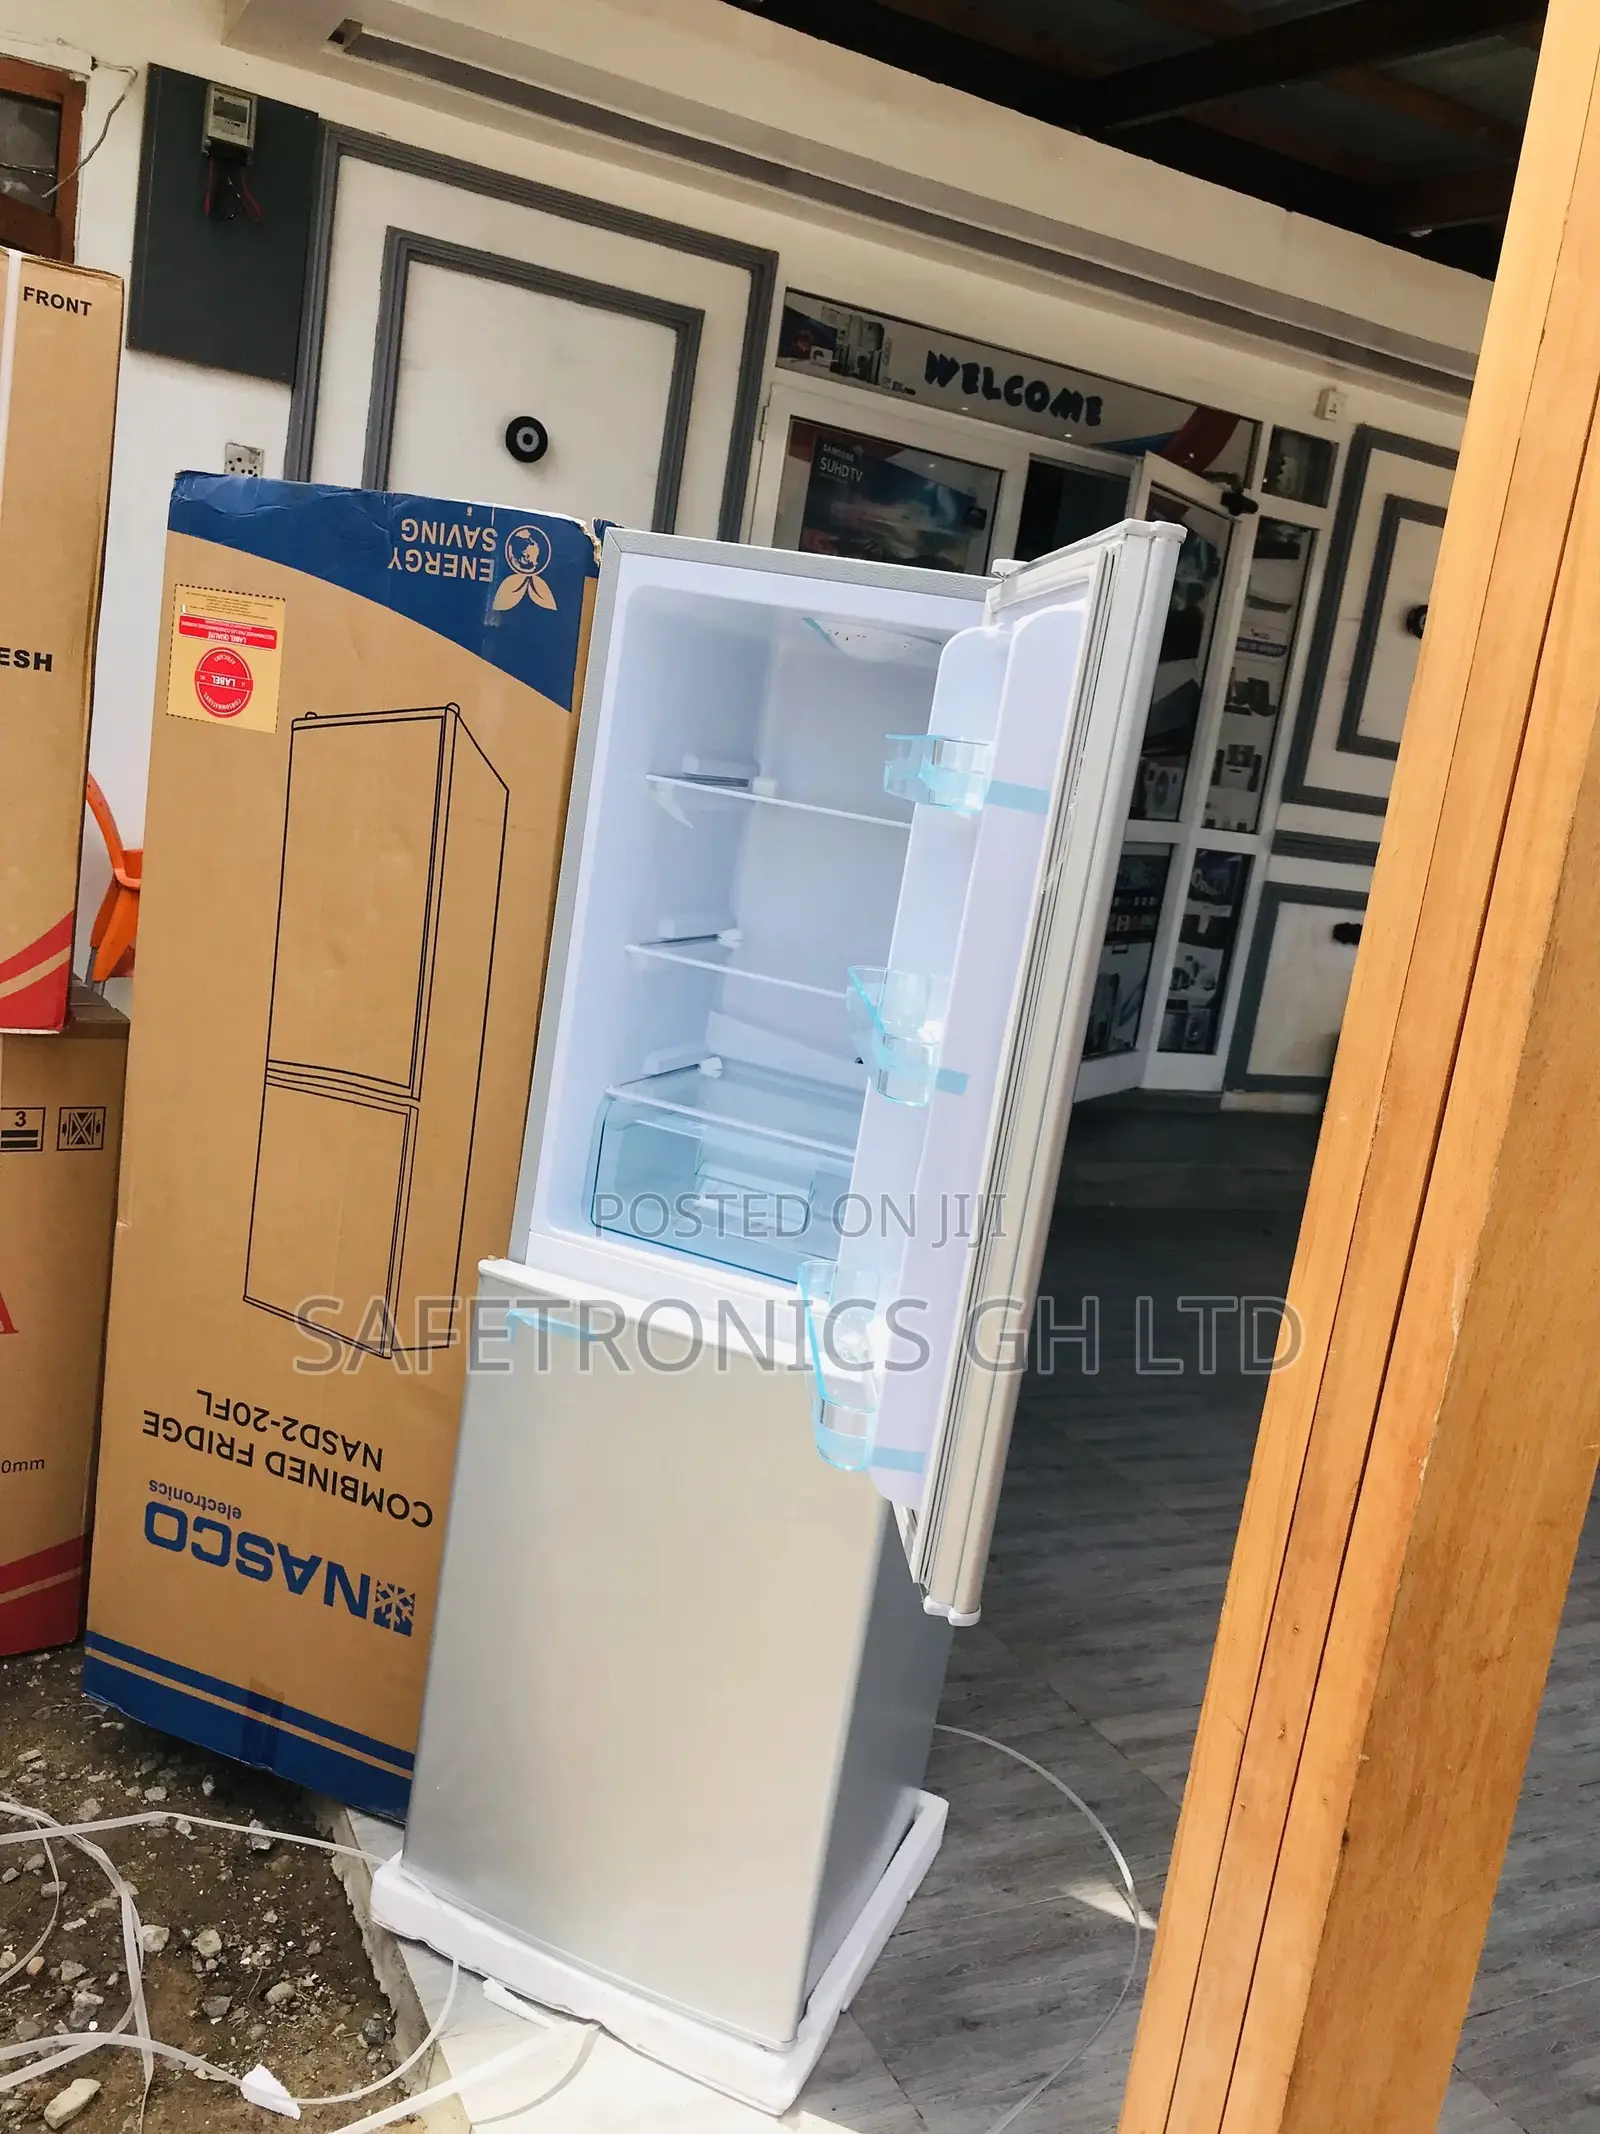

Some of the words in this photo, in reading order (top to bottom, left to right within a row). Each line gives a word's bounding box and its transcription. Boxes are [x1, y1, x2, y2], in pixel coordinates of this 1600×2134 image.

[23, 286, 92, 316] FRONT
[924, 350, 1103, 427] WELCOME
[401, 518, 498, 552] SAVING
[387, 546, 494, 583] ENERGY
[211, 675, 235, 687] LABEL
[15, 1111, 26, 1127] 3
[142, 1409, 254, 1468] FRIDGE
[196, 1388, 383, 1472] NASD2-20FL
[148, 1479, 242, 1520] electronics
[265, 1450, 434, 1528] COMBINED
[144, 1501, 371, 1620] NASCO
